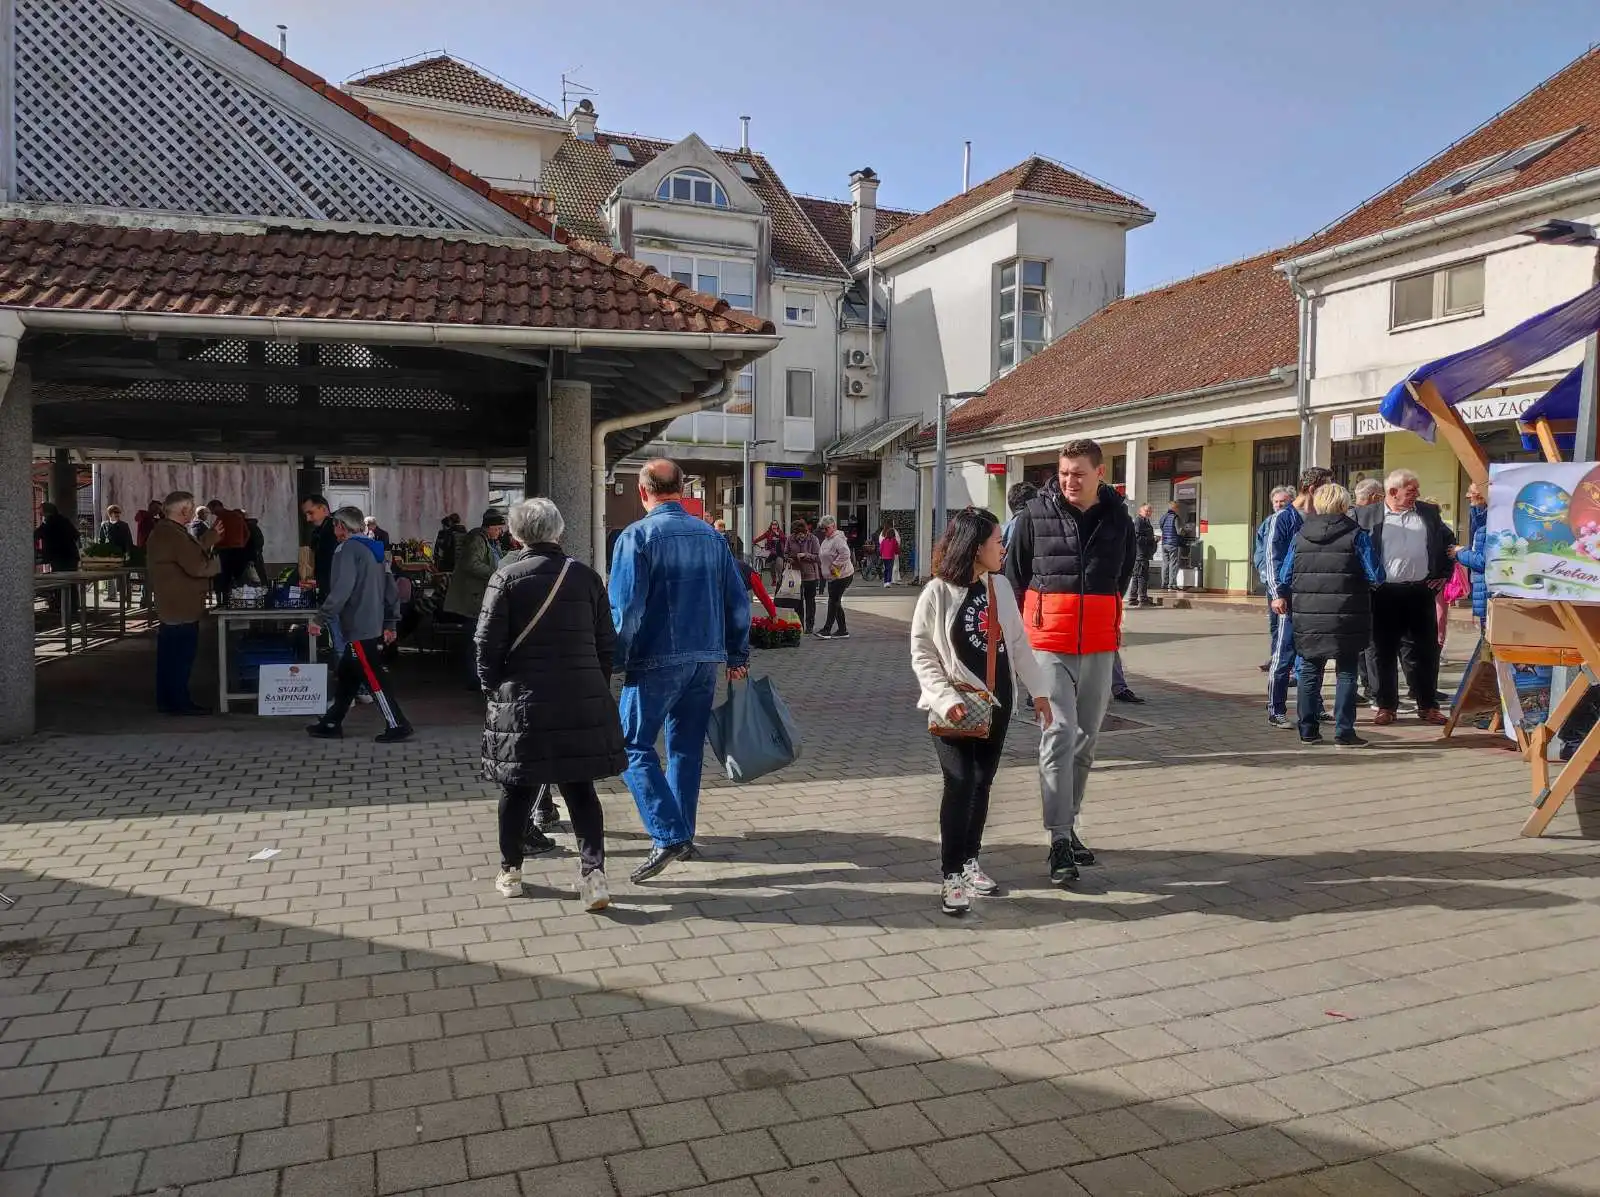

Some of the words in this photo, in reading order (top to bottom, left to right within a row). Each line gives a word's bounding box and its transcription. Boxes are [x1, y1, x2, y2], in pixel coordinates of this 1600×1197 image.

[1359, 417, 1392, 432] PRIV
[1460, 405, 1493, 419] NKA
[964, 606, 976, 632] RED
[972, 593, 988, 606] HO
